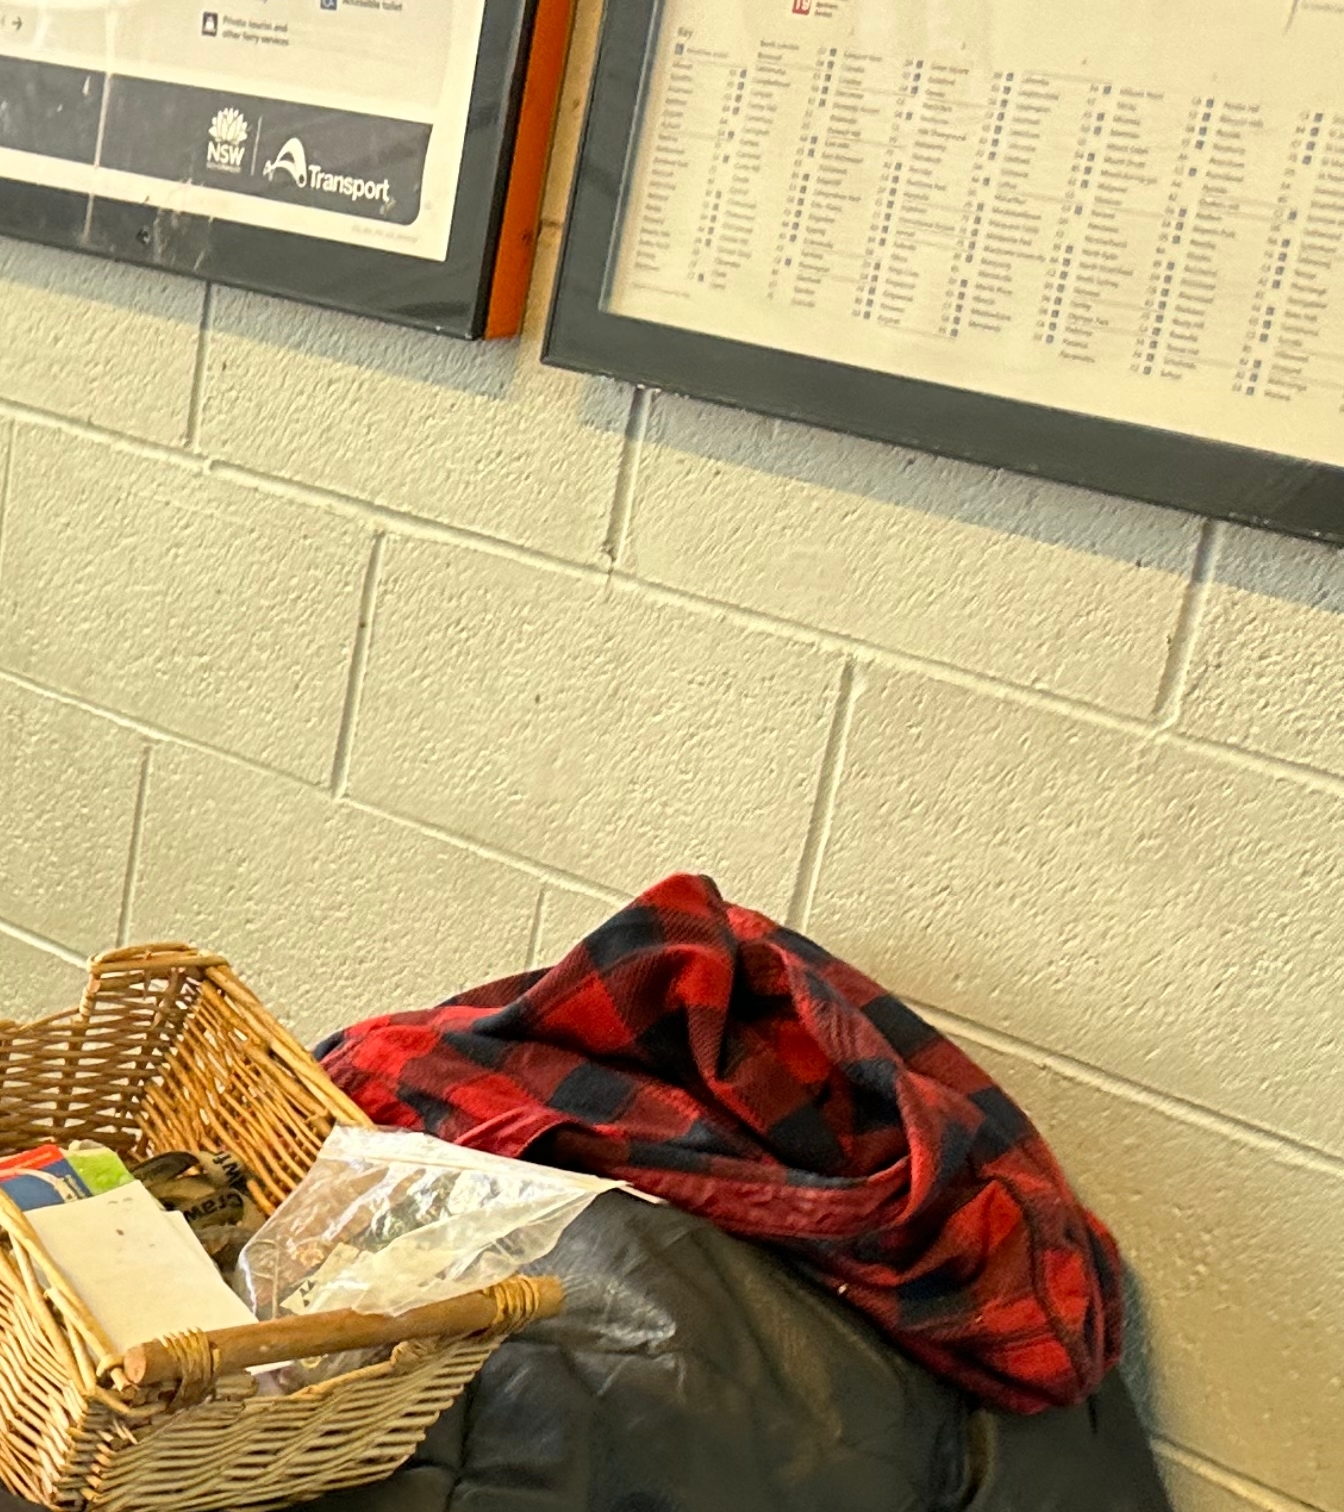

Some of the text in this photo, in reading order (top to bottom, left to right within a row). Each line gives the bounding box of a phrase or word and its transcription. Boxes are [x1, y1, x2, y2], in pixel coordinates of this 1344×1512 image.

[273, 21, 288, 33] and
[243, 31, 260, 44] ferry
[206, 141, 245, 166] NSW
[308, 165, 390, 201] Transport
